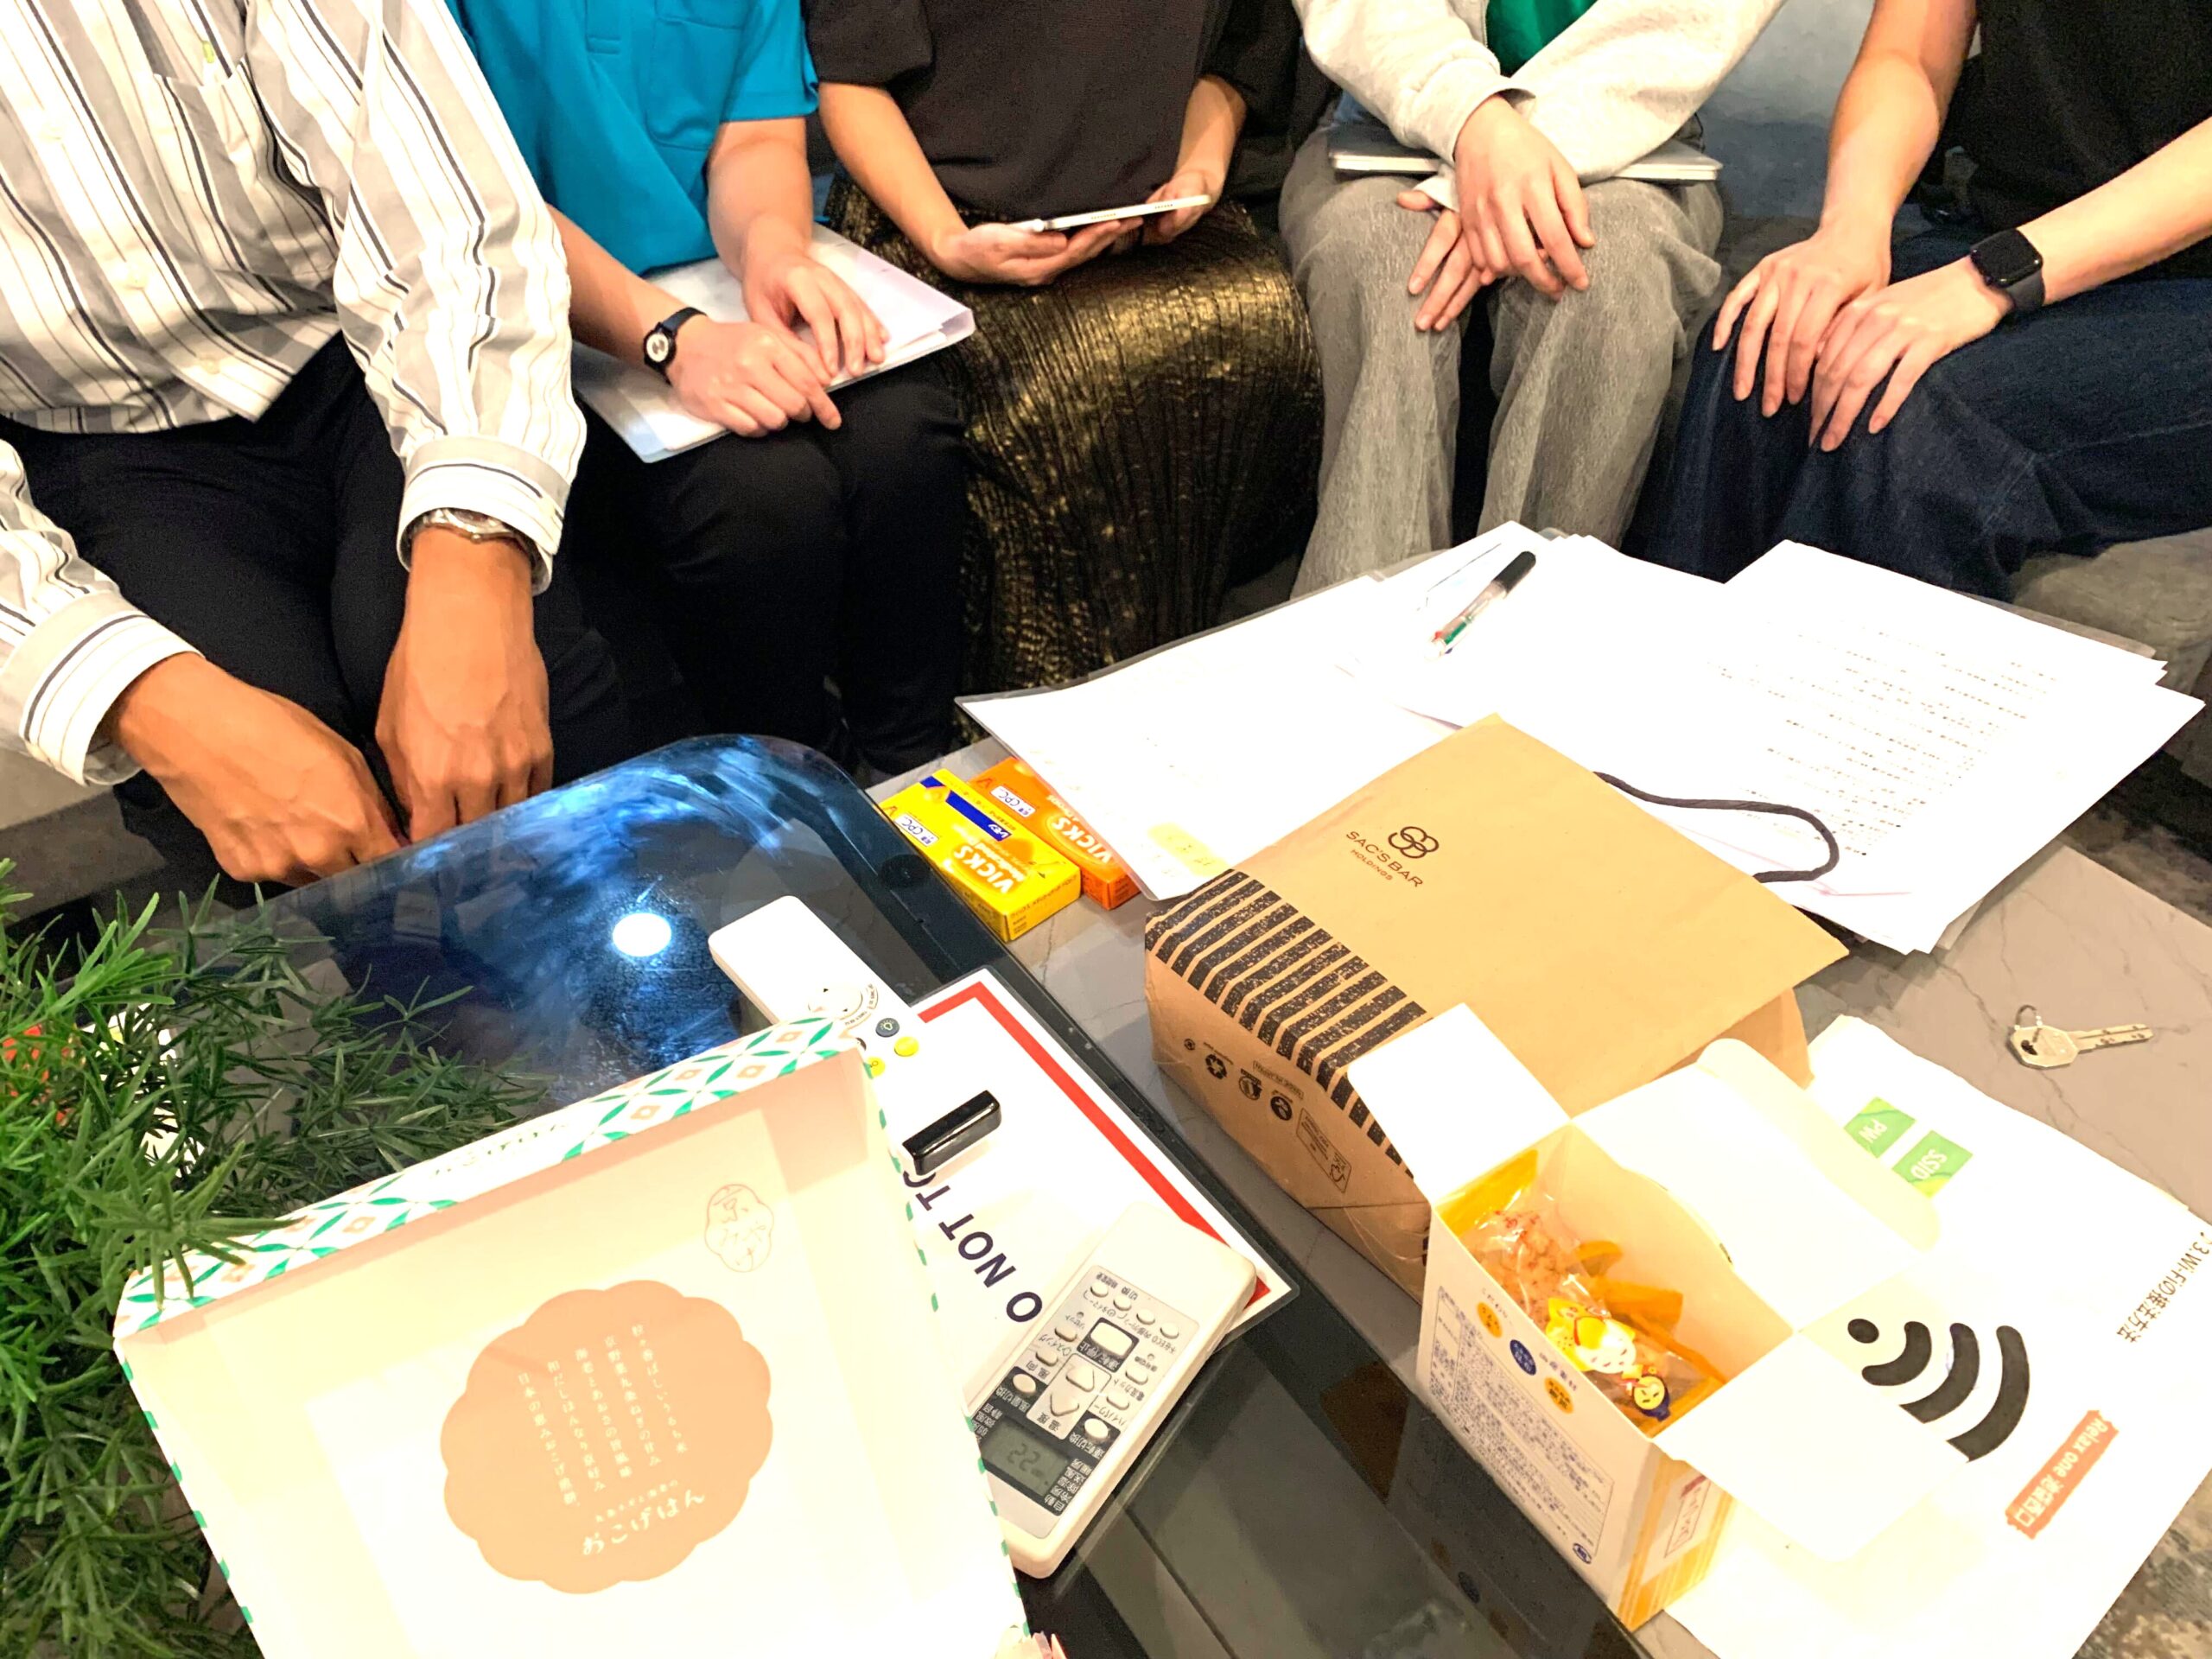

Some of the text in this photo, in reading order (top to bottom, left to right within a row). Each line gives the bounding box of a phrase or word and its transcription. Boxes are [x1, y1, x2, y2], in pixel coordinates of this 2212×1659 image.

[998, 791, 1020, 808] CPC
[901, 818, 924, 836] CPC
[987, 823, 1008, 839] レモン
[1052, 817, 1112, 865] VICKS
[954, 846, 1015, 893] VICKS
[1346, 831, 1423, 887] SAC'S BAR
[1351, 849, 1393, 880] HOLDINGS
[1859, 1118, 1887, 1143] PW
[1910, 1147, 1948, 1182] SSID
[938, 1215, 1016, 1287] NOT
[1122, 1287, 1137, 1300] 切換
[1007, 1292, 1042, 1322] O
[1080, 1342, 1119, 1370] 運転/停止
[1026, 1361, 1050, 1379] 風向
[995, 1384, 1030, 1412] 風量切換
[1037, 1413, 1059, 1431] 温度
[1091, 1401, 1125, 1426] ハイパワー
[1070, 1433, 1104, 1459] 運転切換
[2072, 1417, 2107, 1457] Relax
[1007, 1443, 1040, 1473] 22
[1071, 1459, 1092, 1477] 暖房
[2052, 1450, 2080, 1479] one
[1058, 1477, 1079, 1493] 除湿
[1065, 1467, 1086, 1484] 送風
[1045, 1495, 1065, 1511] 自動
[1051, 1485, 1072, 1504] 冷房
[583, 1490, 704, 1554] おこげはん
